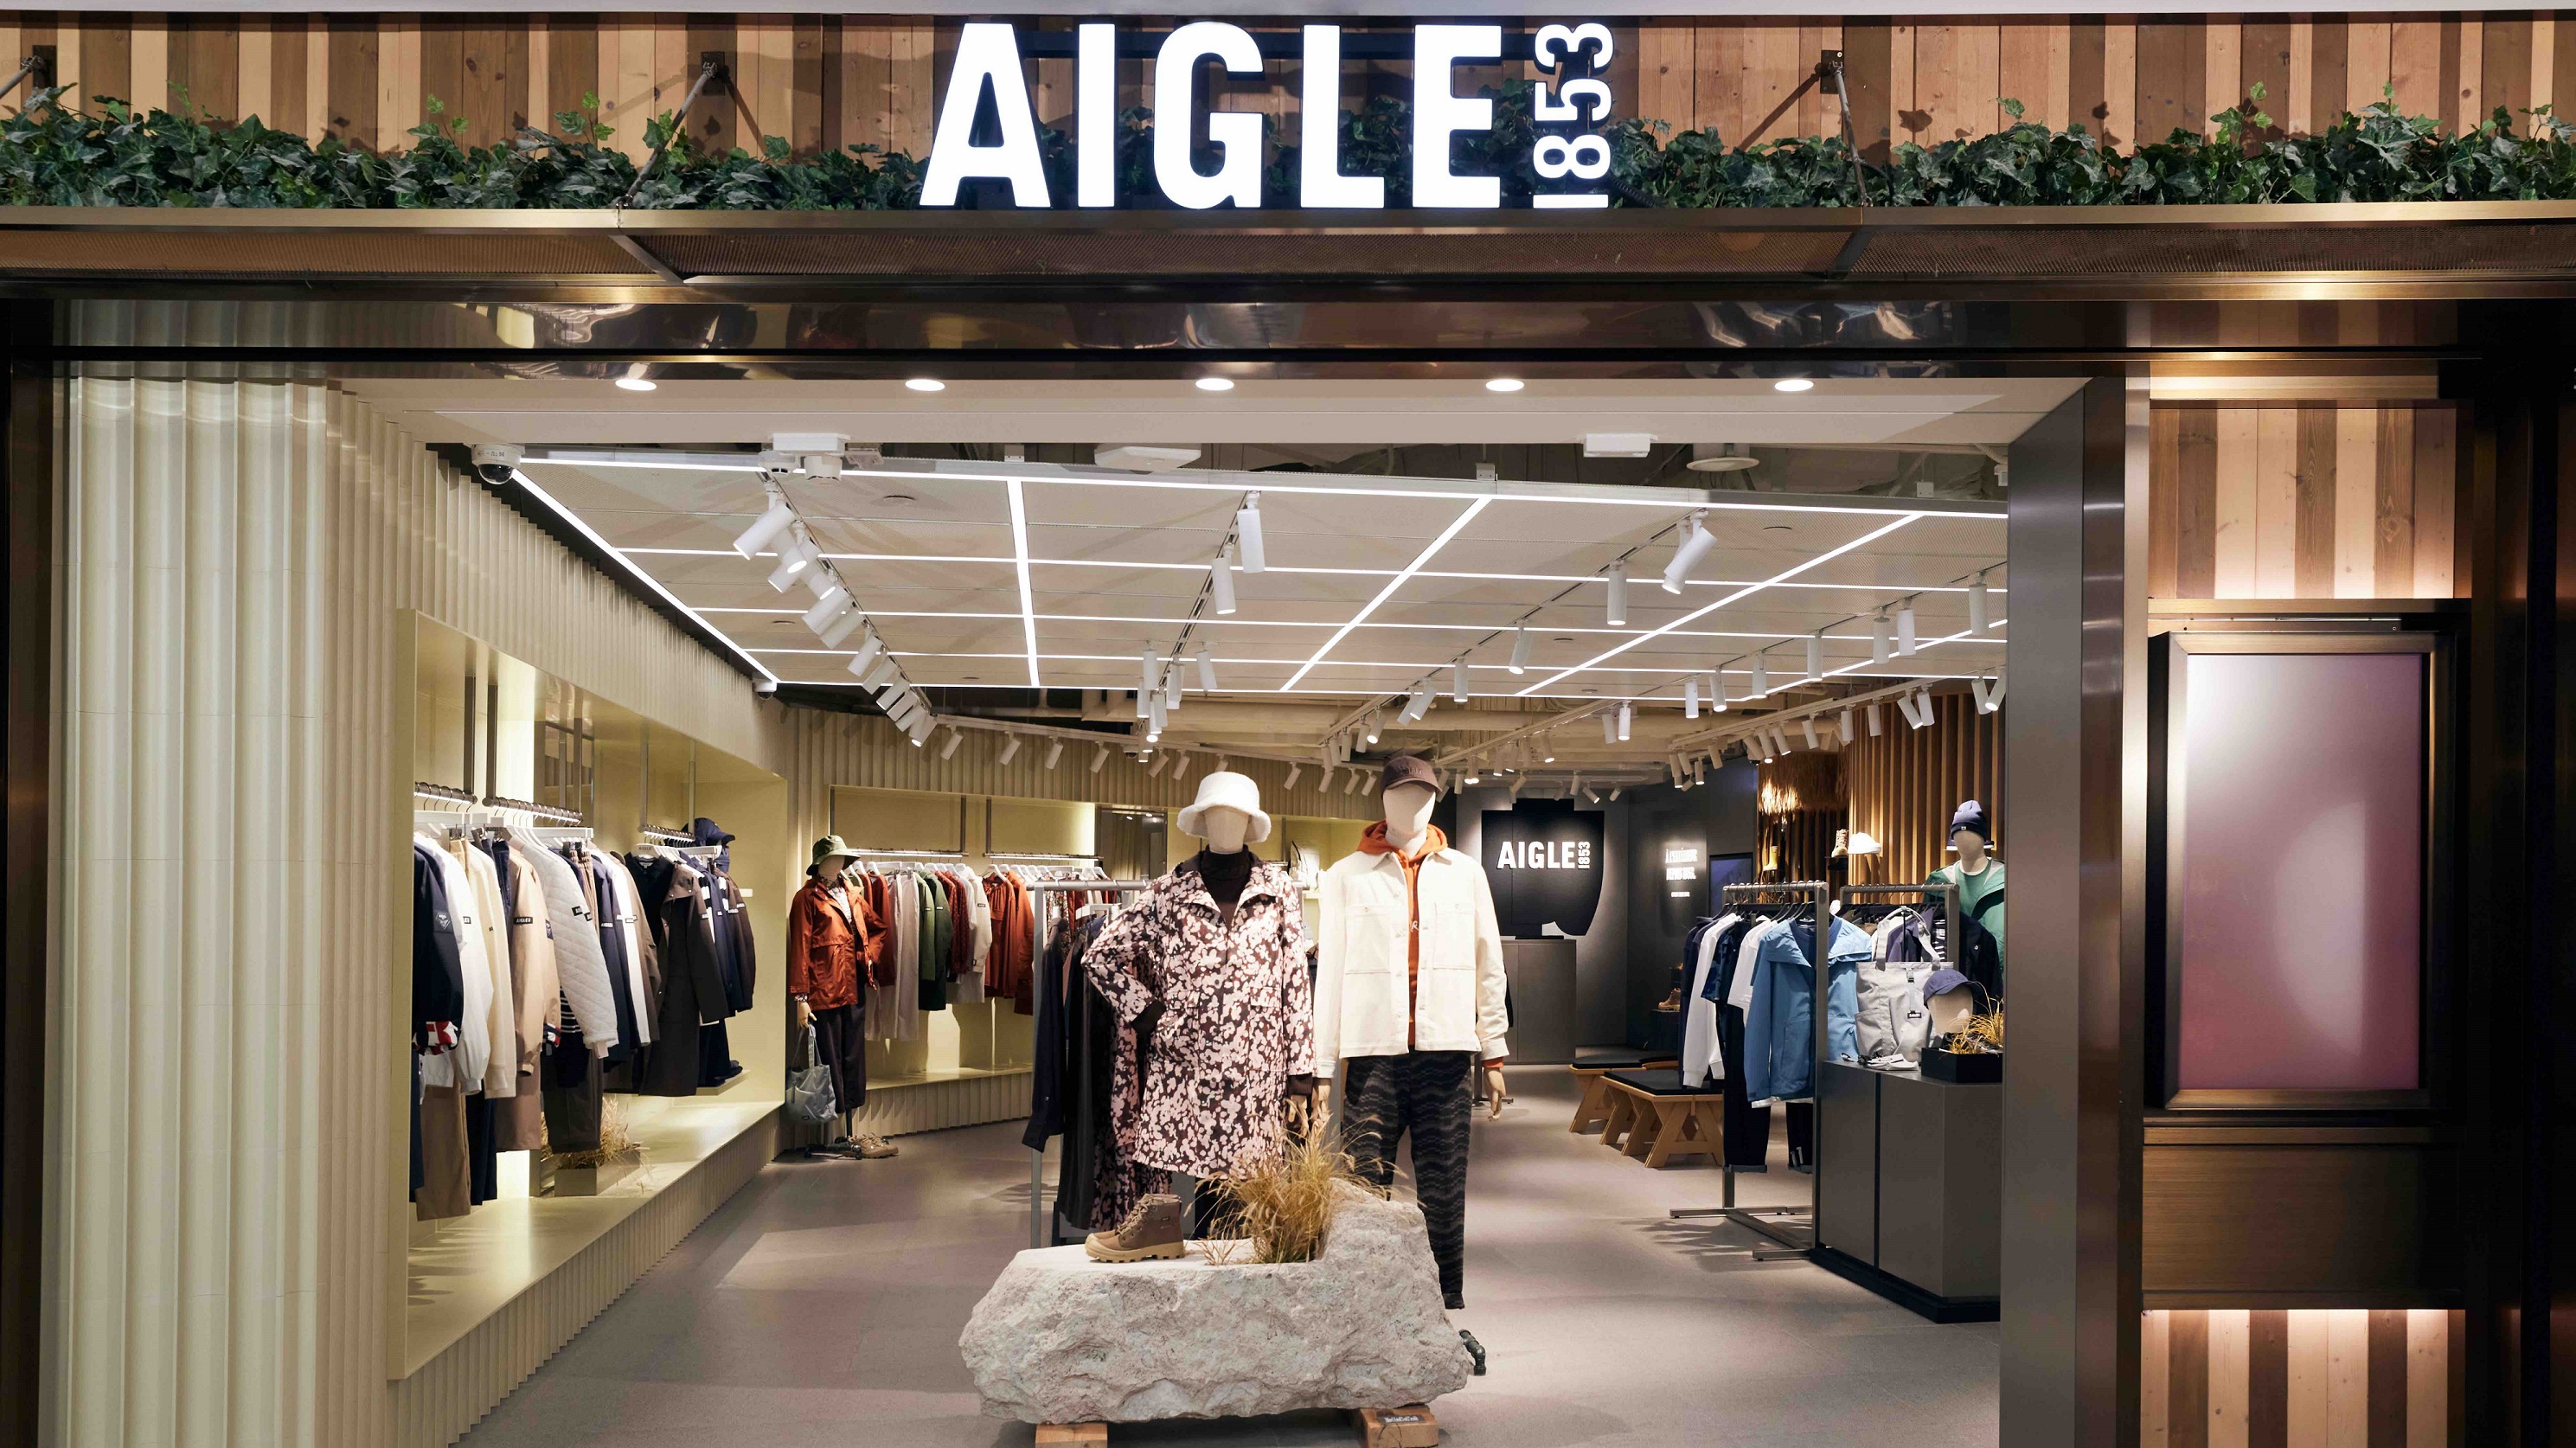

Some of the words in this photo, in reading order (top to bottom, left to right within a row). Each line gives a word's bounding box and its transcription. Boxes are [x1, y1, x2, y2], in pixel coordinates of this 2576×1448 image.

[919, 22, 1503, 209] AIGLE
[1533, 22, 1614, 209] 1853
[1497, 841, 1575, 869] AIGLE
[1577, 841, 1591, 869] 1853
